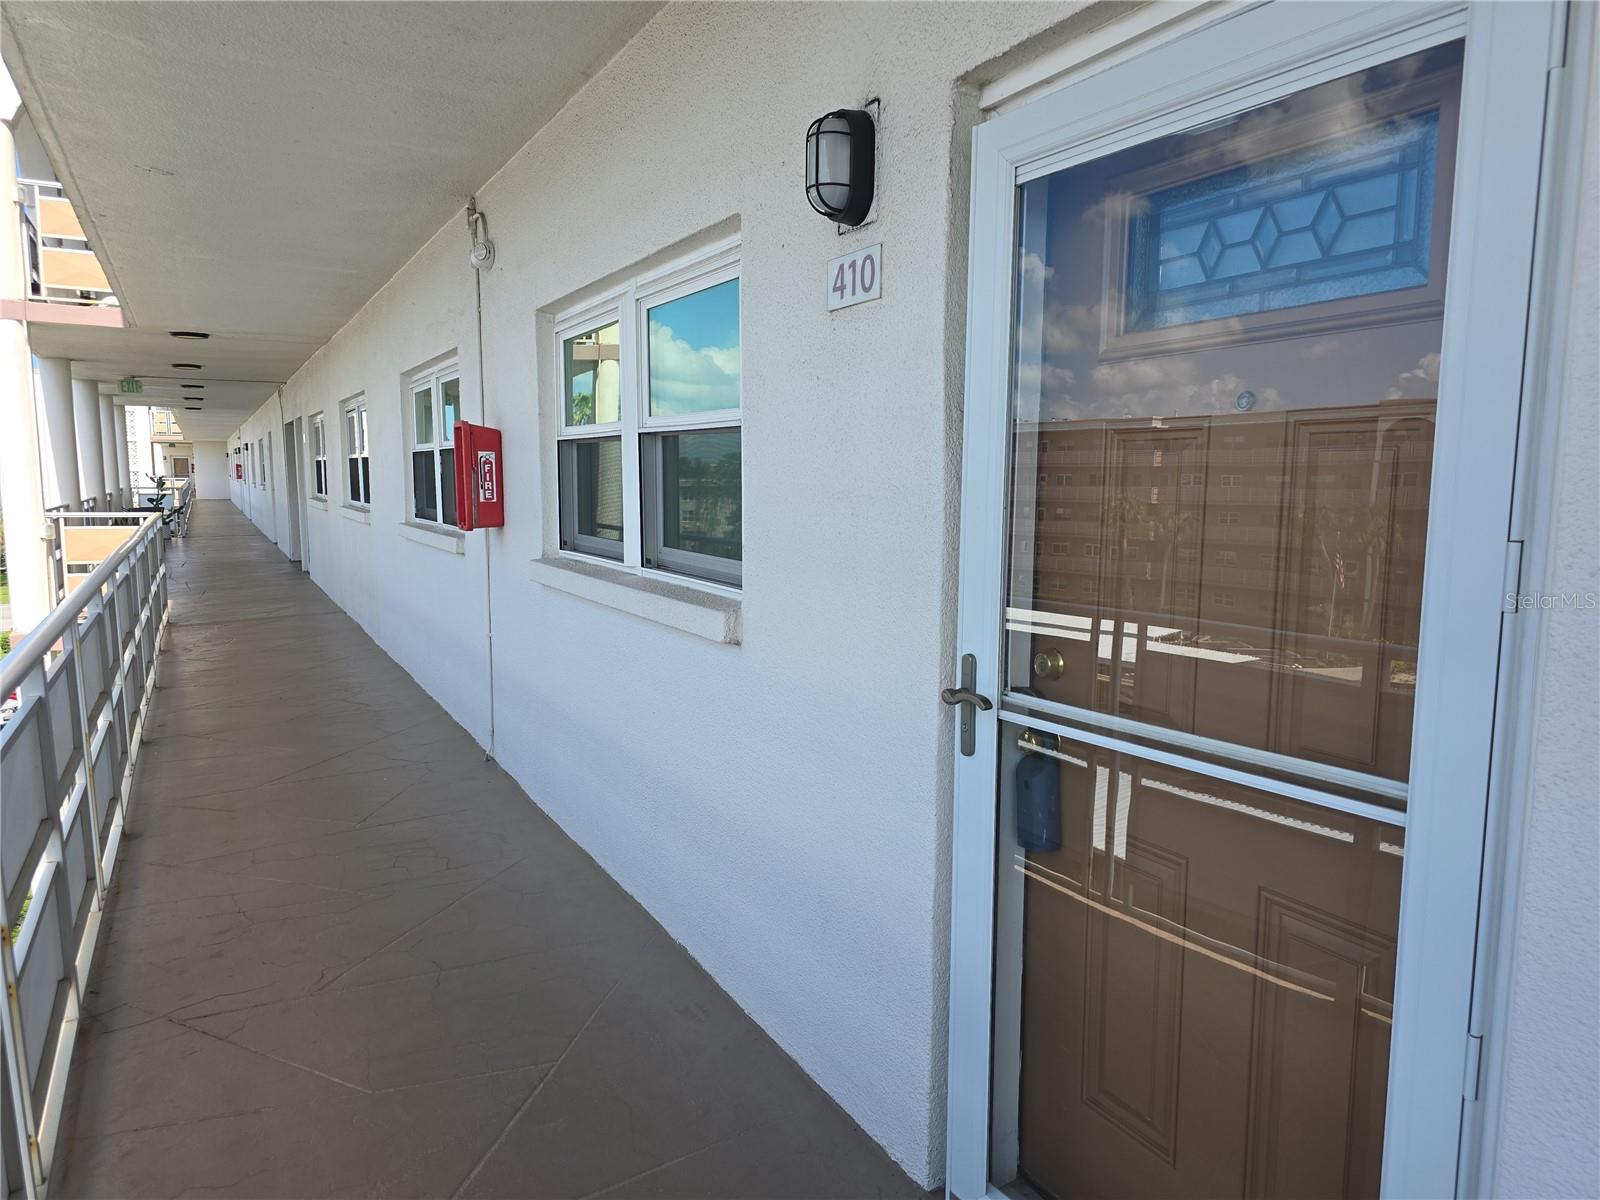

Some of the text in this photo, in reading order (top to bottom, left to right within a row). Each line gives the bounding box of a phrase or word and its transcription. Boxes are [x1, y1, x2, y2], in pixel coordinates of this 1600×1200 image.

[832, 254, 876, 300] 410
[121, 380, 142, 393] EXIT
[484, 464, 492, 499] FIRE
